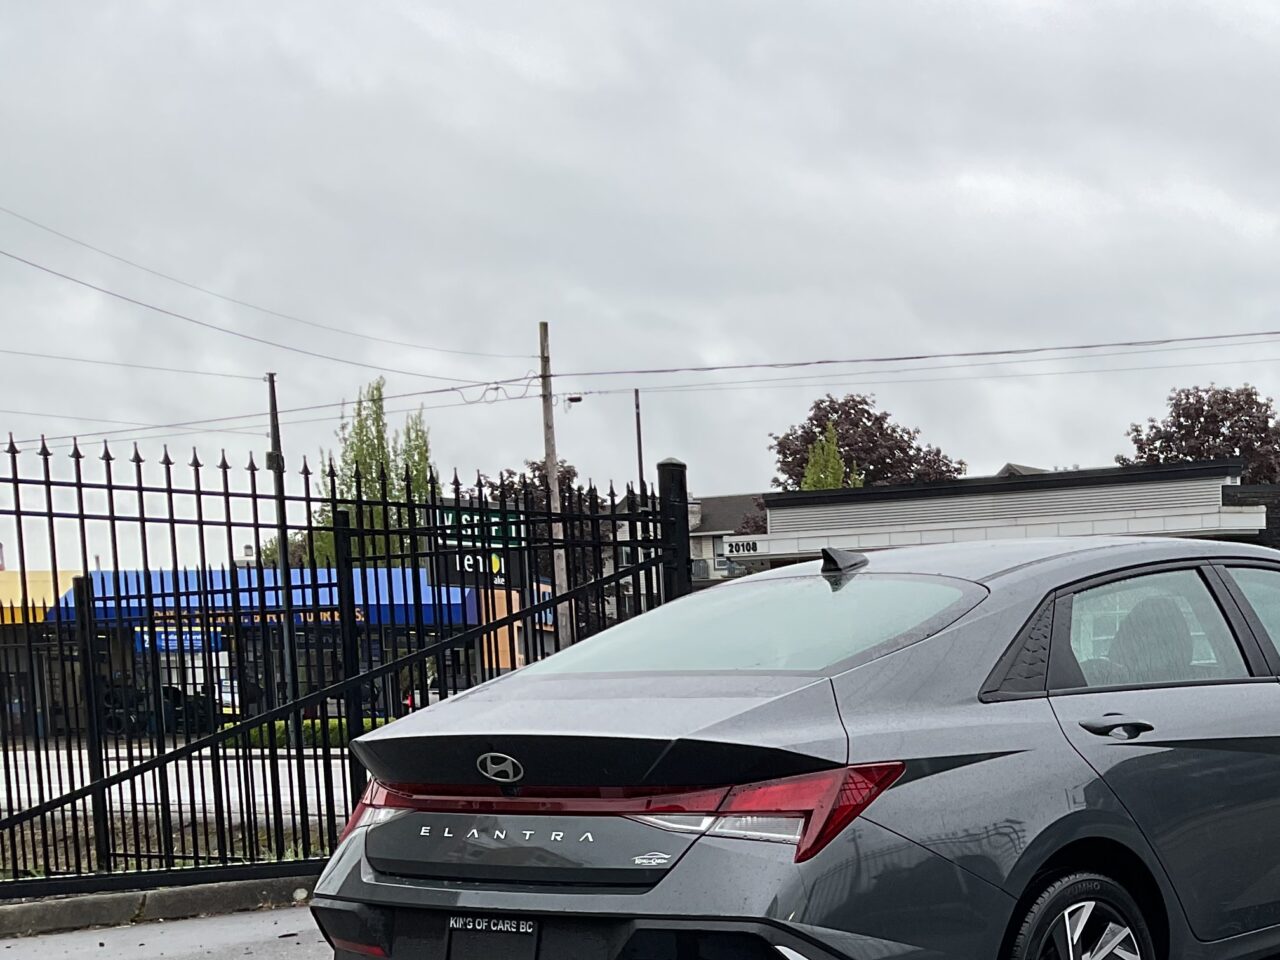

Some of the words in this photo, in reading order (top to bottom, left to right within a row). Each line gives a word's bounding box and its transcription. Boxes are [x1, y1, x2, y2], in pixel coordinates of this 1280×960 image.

[728, 541, 758, 553] 20108
[419, 826, 594, 842] ELANTRA
[449, 916, 473, 929] KING
[475, 918, 488, 930] OF
[490, 919, 517, 932] CARS
[519, 921, 534, 933] BC
